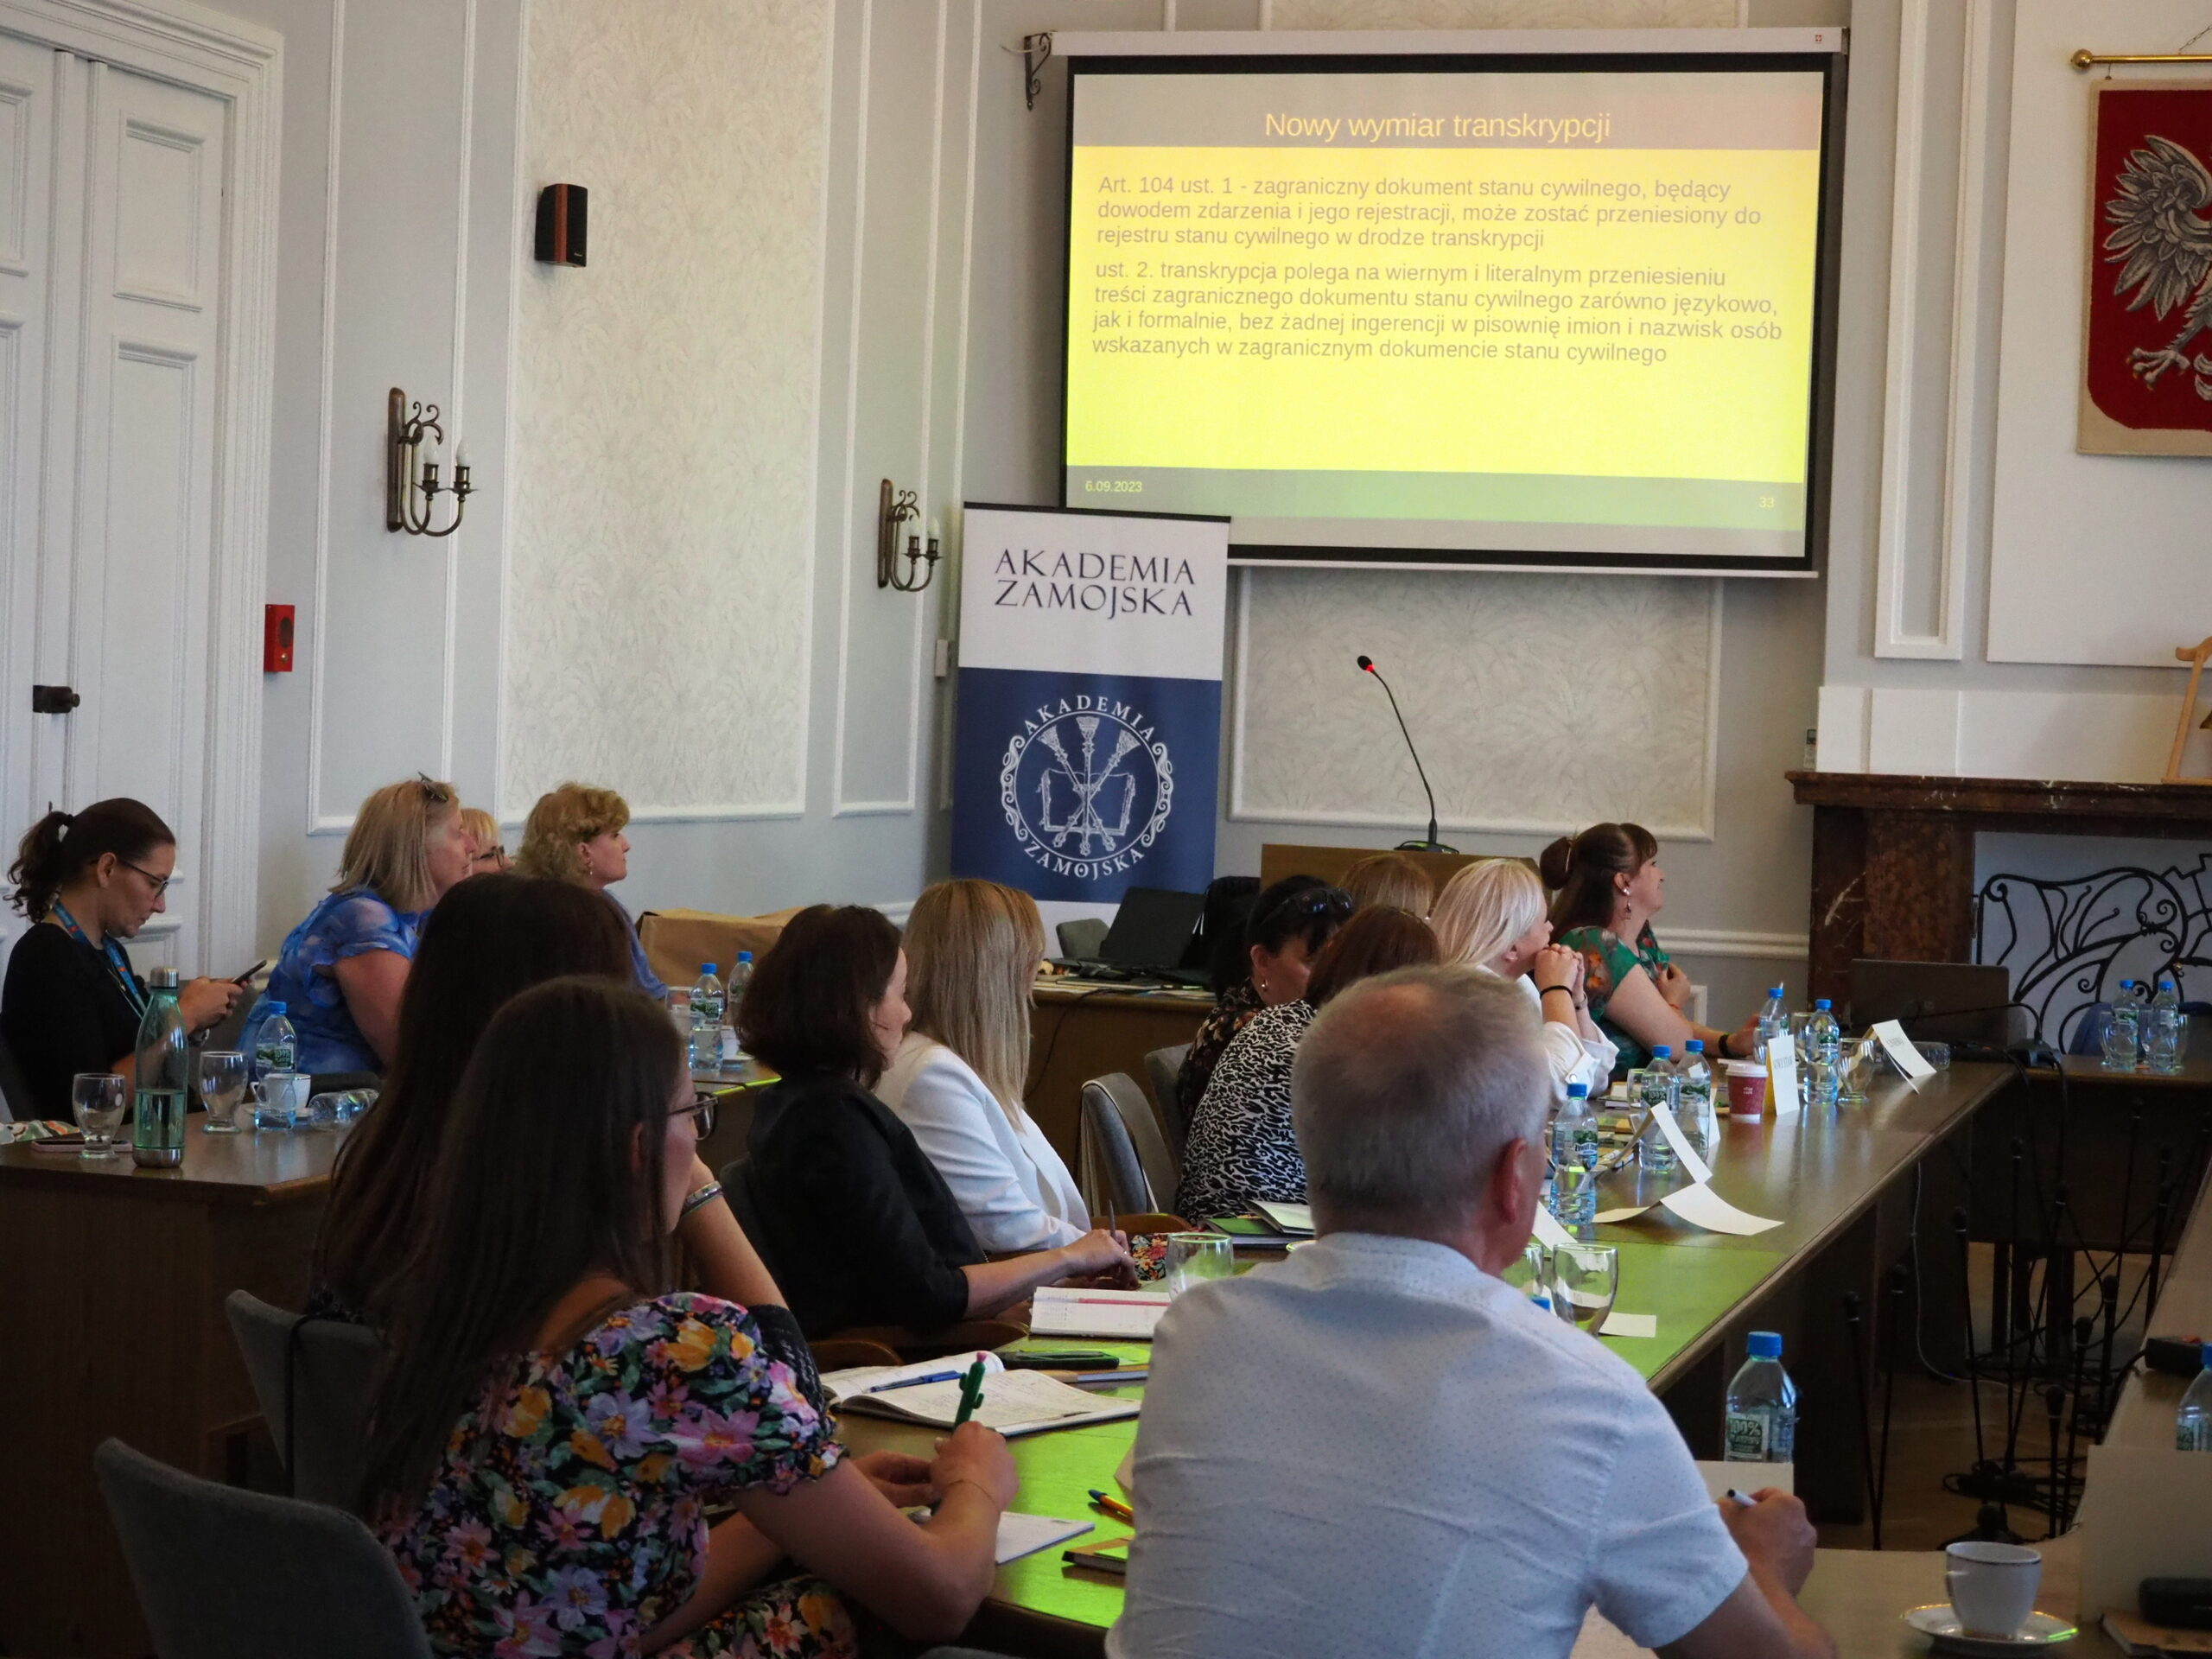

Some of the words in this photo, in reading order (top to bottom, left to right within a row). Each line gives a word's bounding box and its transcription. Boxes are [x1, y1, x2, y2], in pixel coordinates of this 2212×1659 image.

[1265, 112, 1340, 143] Nowy
[1348, 112, 1445, 143] wymiar
[1453, 112, 1611, 143] transkrypcji
[1098, 175, 1132, 194] Art.
[1139, 176, 1175, 194] 104
[1180, 177, 1214, 194] ust.
[1222, 176, 1233, 194] 1
[1253, 176, 1370, 200] zagraniczny
[1375, 176, 1473, 196] dokument
[1478, 179, 1534, 196] stanu
[1540, 178, 1646, 202] cywilnego,
[1655, 179, 1732, 204] będący
[1097, 200, 1191, 219] dowodem
[1197, 200, 1292, 219] zdarzenia
[1298, 201, 1302, 219] i
[1307, 201, 1351, 226] jego
[1356, 202, 1455, 226] rejestracji,
[1463, 203, 1517, 222] może
[1523, 203, 1589, 223] zostać
[1596, 204, 1728, 229] przeniesiony
[1734, 206, 1762, 225] do
[1097, 225, 1169, 248] rejestru
[1174, 227, 1228, 245] stanu
[1234, 226, 1330, 250] cywilnego
[1335, 232, 1353, 245] w
[1357, 227, 1425, 246] drodze
[1431, 227, 1544, 252] transkrypcji
[1096, 262, 1128, 278] ust.
[1136, 260, 1154, 278] 2.
[1160, 261, 1278, 284] transkrypcja
[1284, 262, 1350, 285] polega
[1356, 266, 1380, 281] na
[1385, 263, 1468, 287] wiernym
[1474, 263, 1479, 282] i
[1485, 263, 1582, 288] literalnym
[1588, 265, 1726, 289] przeniesieniu
[1094, 284, 1146, 303] treści
[1152, 285, 1294, 310] zagranicznego
[1299, 287, 1408, 306] dokumentu
[1414, 290, 1468, 308] stanu
[1474, 289, 1573, 314] cywilnego
[1580, 290, 1667, 311] zarówno
[1672, 292, 1777, 317] językowo,
[1091, 310, 1123, 334] jak
[1127, 310, 1132, 328] i
[1138, 309, 1232, 333] formalnie,
[1239, 312, 1274, 330] bez
[1281, 312, 1344, 336] żadnej
[1351, 313, 1445, 338] ingerencji
[1451, 318, 1468, 333] w
[1473, 315, 1560, 342] pisownię
[1567, 315, 1621, 335] imion
[1627, 317, 1632, 335] i
[1639, 318, 1724, 339] nazwisk
[1730, 321, 1783, 340] osób
[1091, 335, 1210, 359] wskazanych
[1216, 341, 1233, 355] w
[1238, 338, 1373, 362] zagranicznym
[1379, 339, 1498, 359] dokumencie
[1504, 342, 1560, 360] stanu
[1567, 342, 1667, 367] cywilnego
[1084, 480, 1143, 493] 6.09.2023
[1758, 496, 1776, 508] 33
[995, 547, 1196, 586] AKADEMIA
[994, 579, 1193, 620] ZAMOJSKA
[1023, 694, 1155, 742] AKADEMIA
[1024, 842, 1145, 880] ZAMOJSKA
